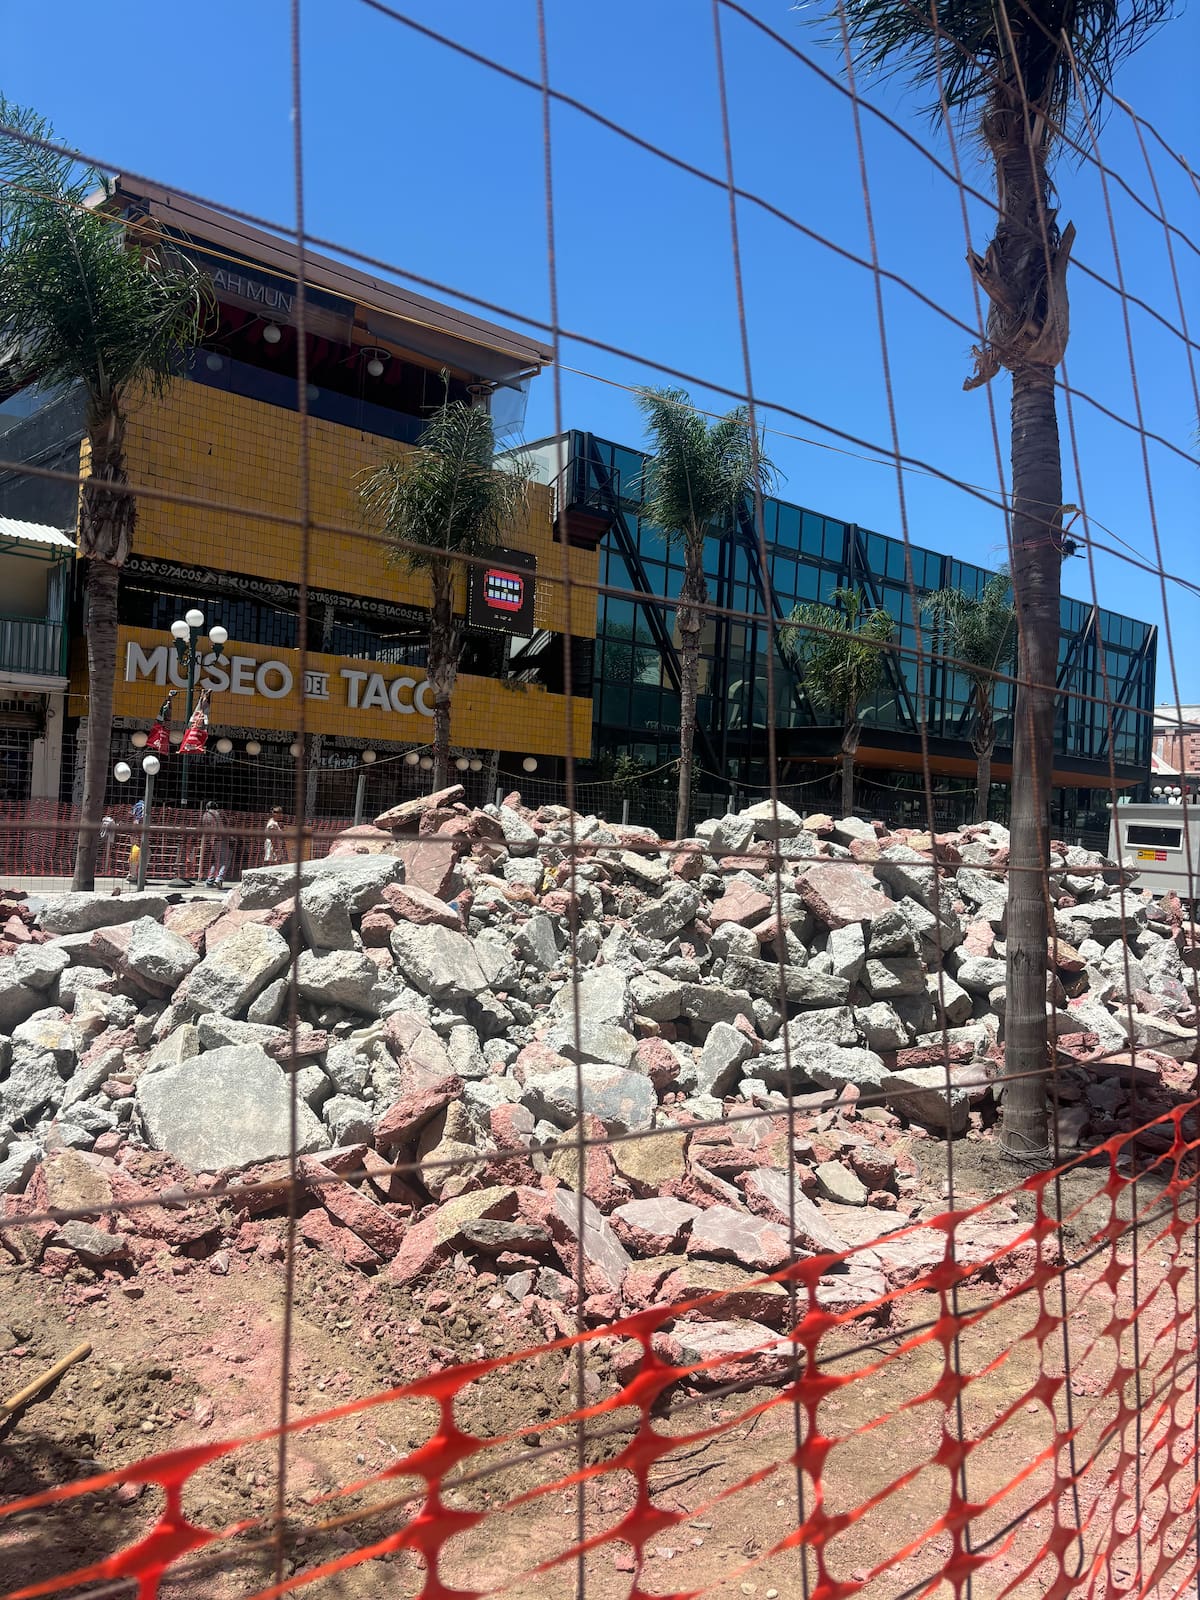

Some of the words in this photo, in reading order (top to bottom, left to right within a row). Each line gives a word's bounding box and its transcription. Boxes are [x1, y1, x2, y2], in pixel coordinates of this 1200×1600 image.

[213, 269, 242, 294] AH
[245, 281, 294, 313] MUN
[166, 565, 202, 581] TACOS
[345, 598, 385, 614] TACOS
[384, 605, 415, 618] TACOS
[125, 641, 294, 699] MUSEO
[303, 674, 330, 696] DEL
